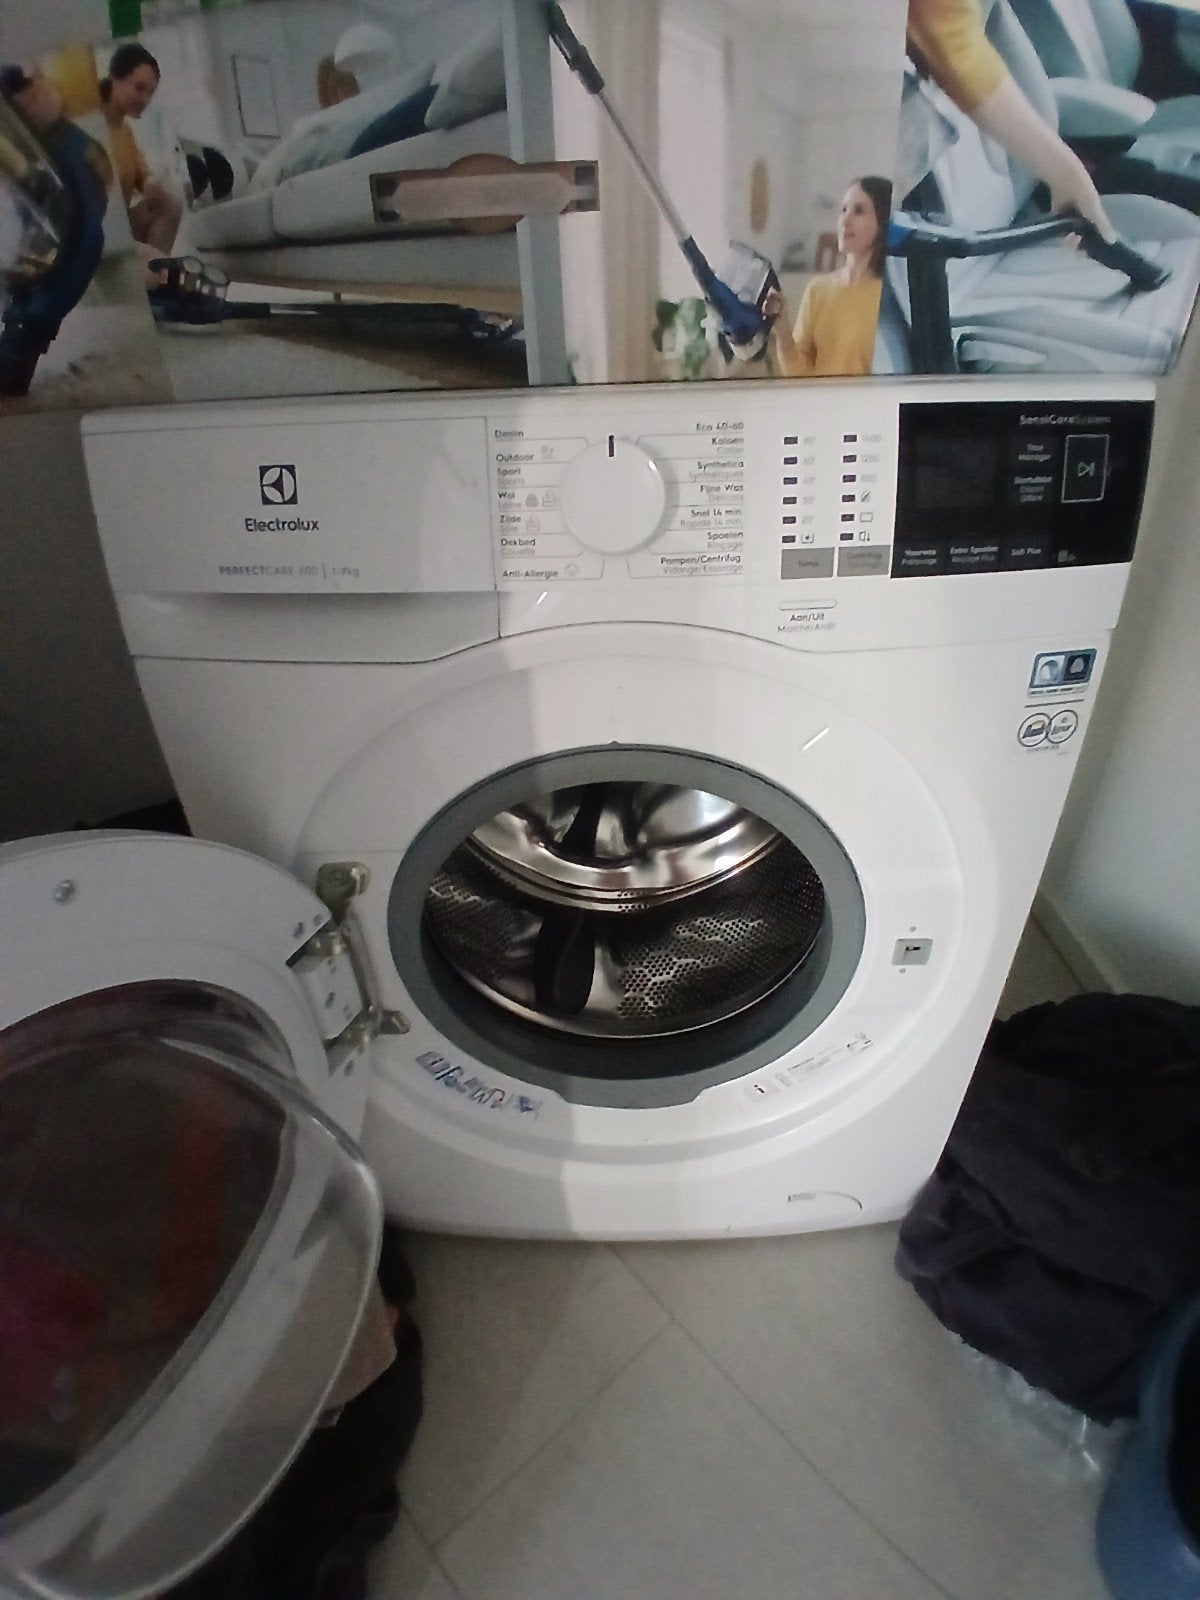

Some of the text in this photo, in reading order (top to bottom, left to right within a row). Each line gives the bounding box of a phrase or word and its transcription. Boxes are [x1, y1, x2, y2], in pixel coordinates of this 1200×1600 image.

[696, 422, 713, 431] Eco
[496, 453, 534, 462] Outdoor
[497, 467, 521, 477] Sport
[691, 509, 710, 517] Snel
[245, 517, 320, 532] Electrolux
[789, 613, 825, 622] Aan/Uit
